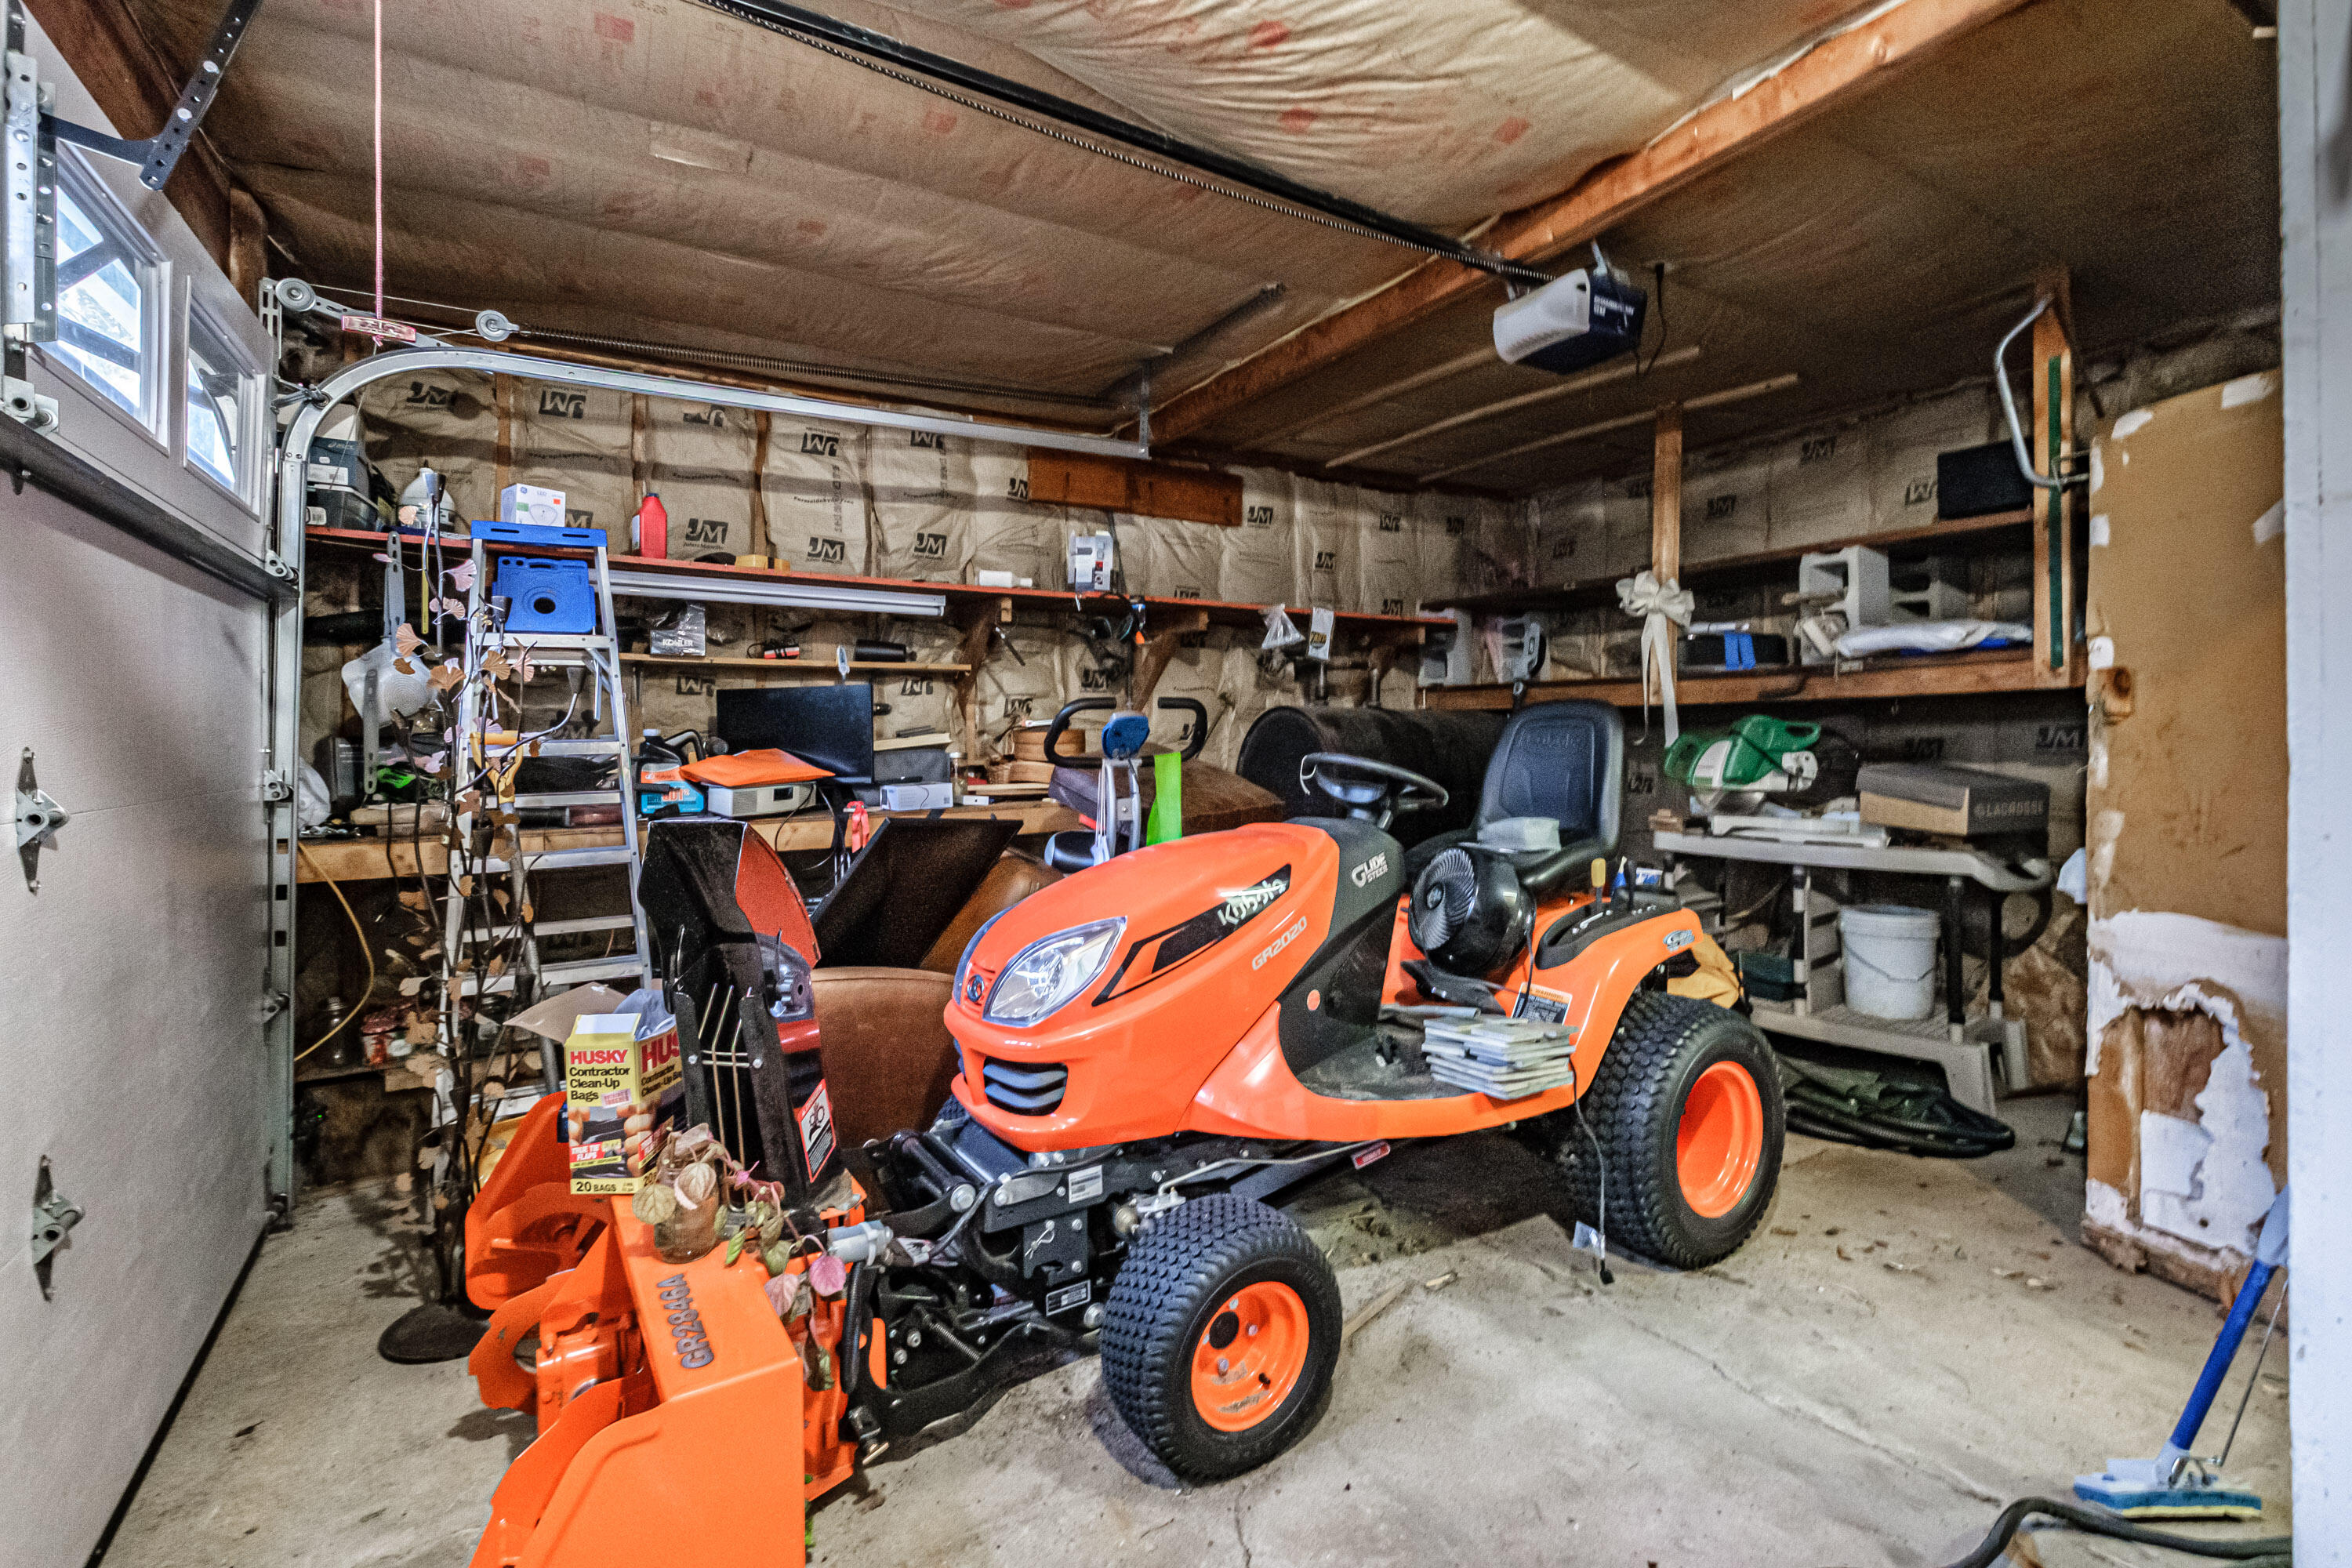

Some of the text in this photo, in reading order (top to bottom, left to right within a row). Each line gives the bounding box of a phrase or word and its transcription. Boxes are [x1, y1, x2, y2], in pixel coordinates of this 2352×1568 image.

[539, 390, 586, 419] JM
[800, 432, 840, 457] JM
[1247, 506, 1273, 524] JM
[686, 518, 728, 544] JM
[808, 536, 845, 561] JM
[914, 532, 947, 556] JM
[1367, 863, 1388, 883] STEER
[1218, 878, 1287, 926] Kubota
[1252, 916, 1308, 971] GR2020
[571, 1049, 628, 1065] HUSKY
[569, 1066, 630, 1077] Contractor
[641, 1064, 676, 1086] Contractor
[570, 1078, 620, 1090] Clean-Up
[571, 1091, 599, 1102] Bags
[576, 1152, 597, 1161] FLAPS
[575, 1181, 592, 1192] 20
[656, 1273, 715, 1369] GR2846A
